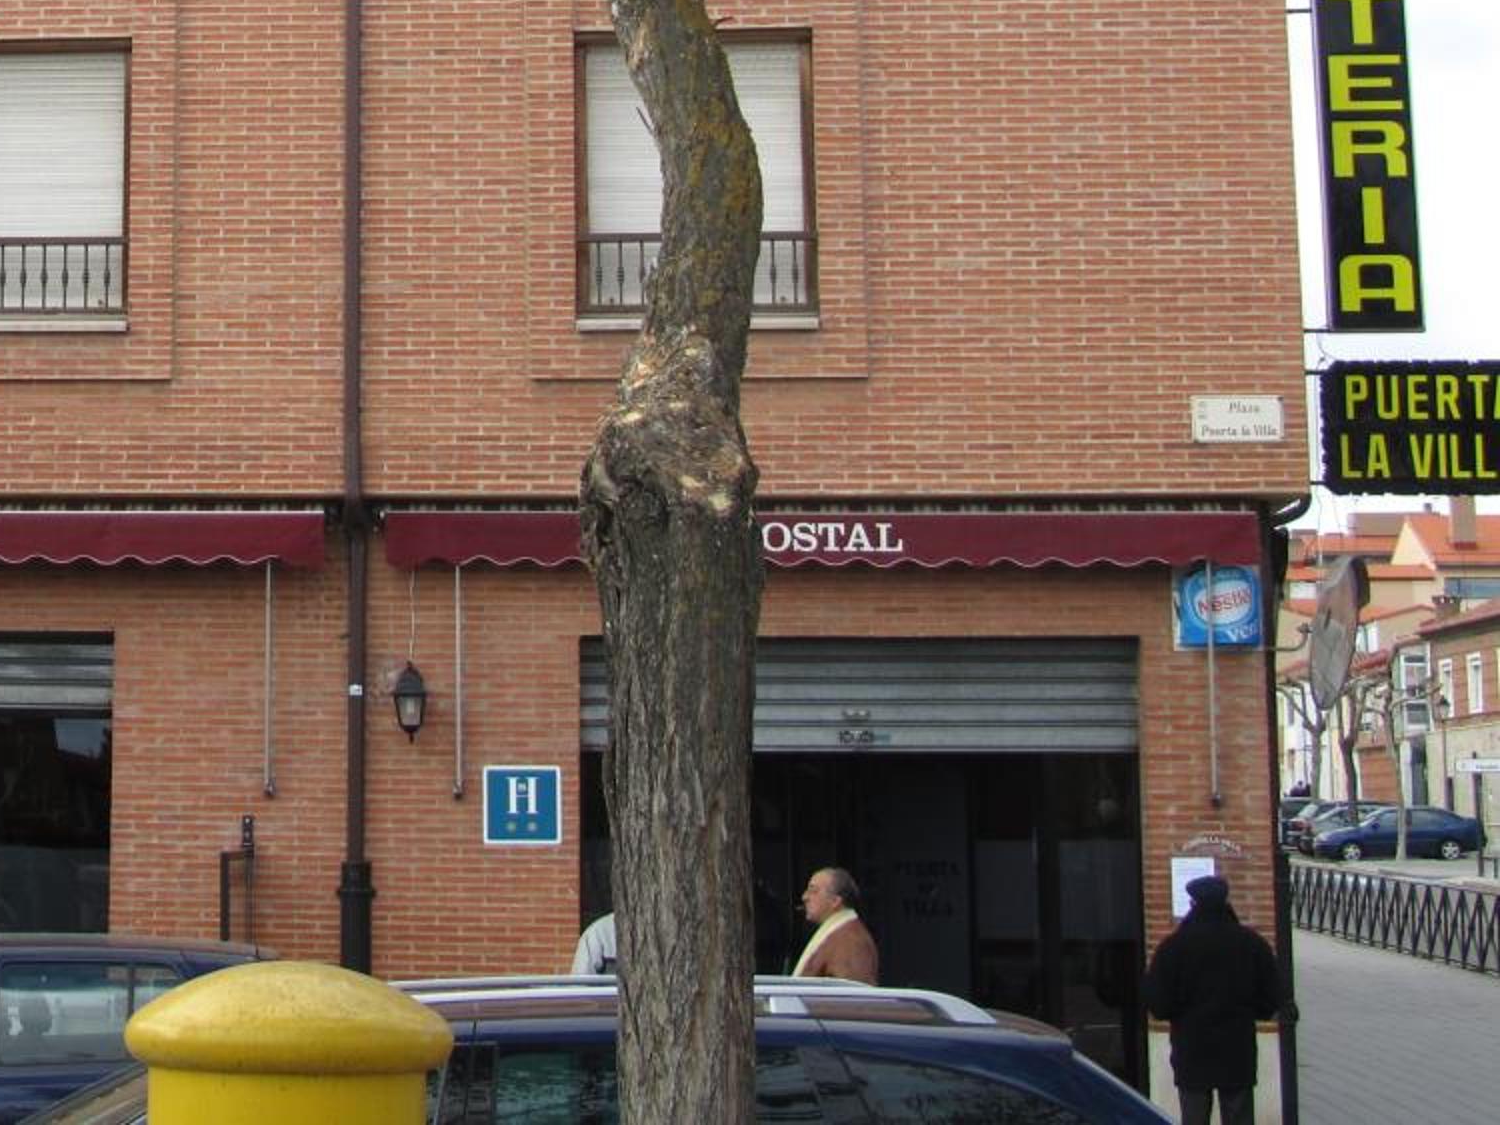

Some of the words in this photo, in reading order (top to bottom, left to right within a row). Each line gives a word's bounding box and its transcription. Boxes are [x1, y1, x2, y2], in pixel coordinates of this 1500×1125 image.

[1344, 374, 1500, 420] PUERT
[1339, 434, 1392, 479] LA
[1408, 434, 1500, 479] VILL
[761, 521, 904, 553] OSTAL
[505, 776, 540, 814] H
